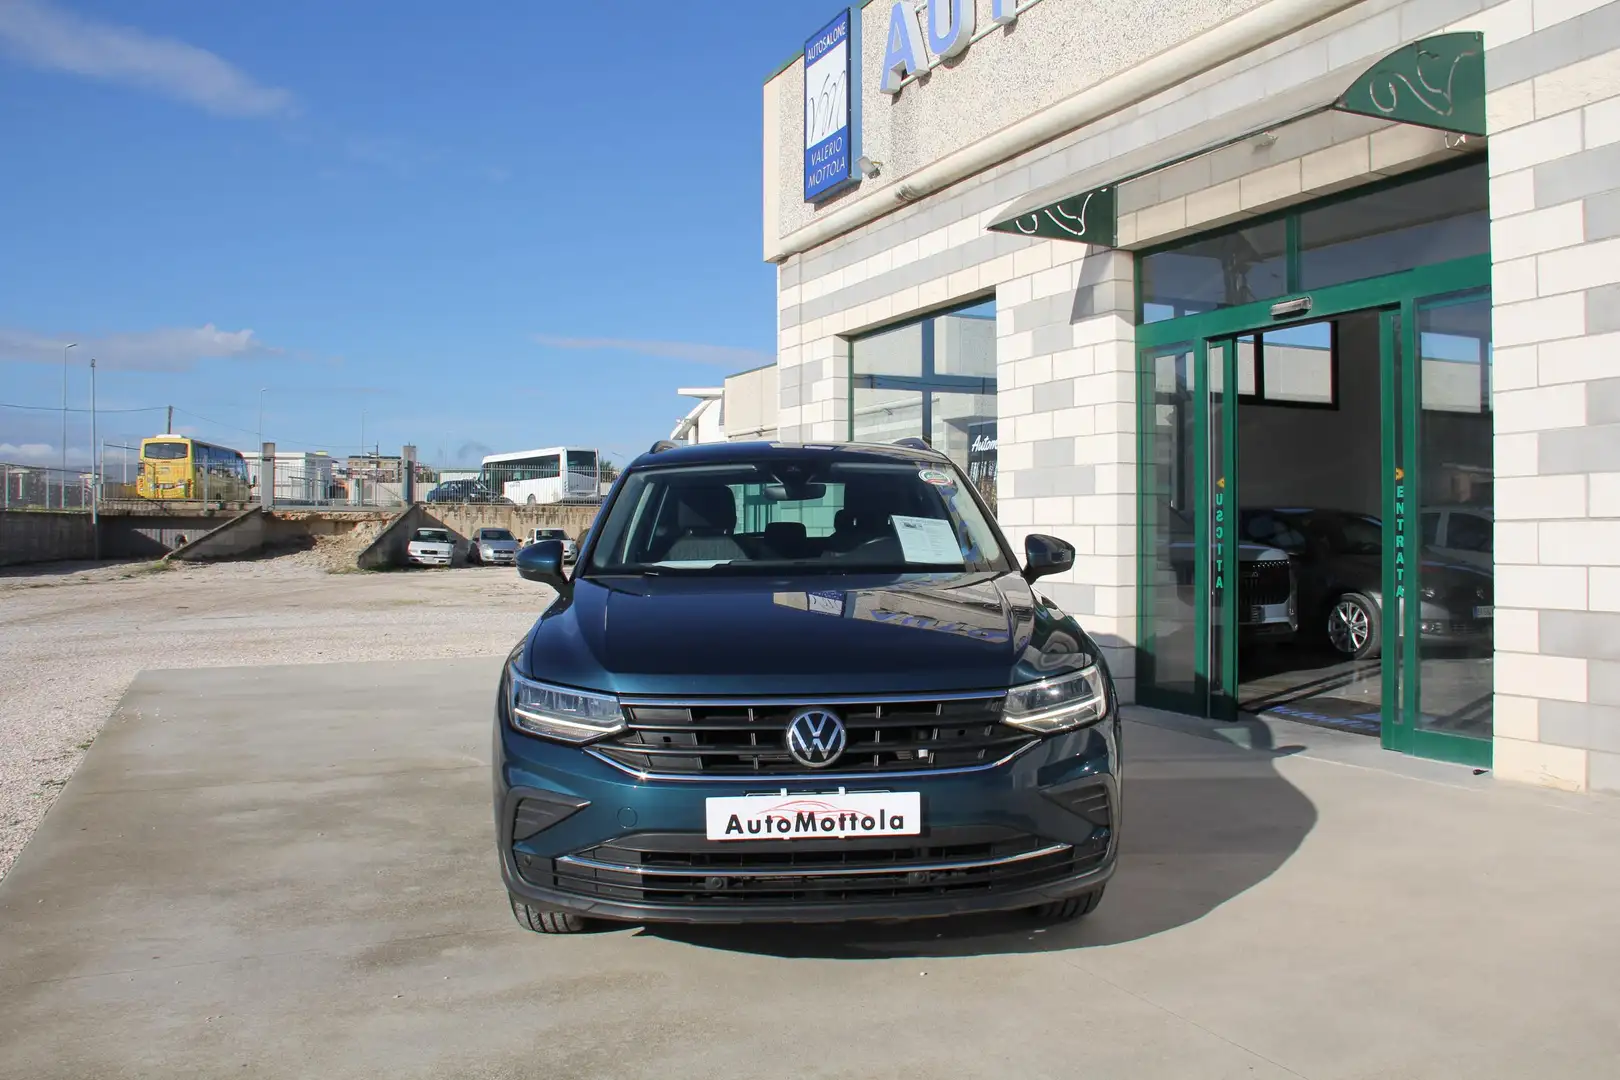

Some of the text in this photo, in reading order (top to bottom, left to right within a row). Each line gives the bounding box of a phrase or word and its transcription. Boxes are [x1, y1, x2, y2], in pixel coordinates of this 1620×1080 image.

[807, 21, 846, 62] AUTOSALONE
[880, 0, 1016, 94] AU
[811, 136, 843, 166] VALERIO
[807, 156, 846, 188] MOTTOLA
[1395, 485, 1405, 598] ENTRATA
[725, 808, 904, 835] AutoMottola
